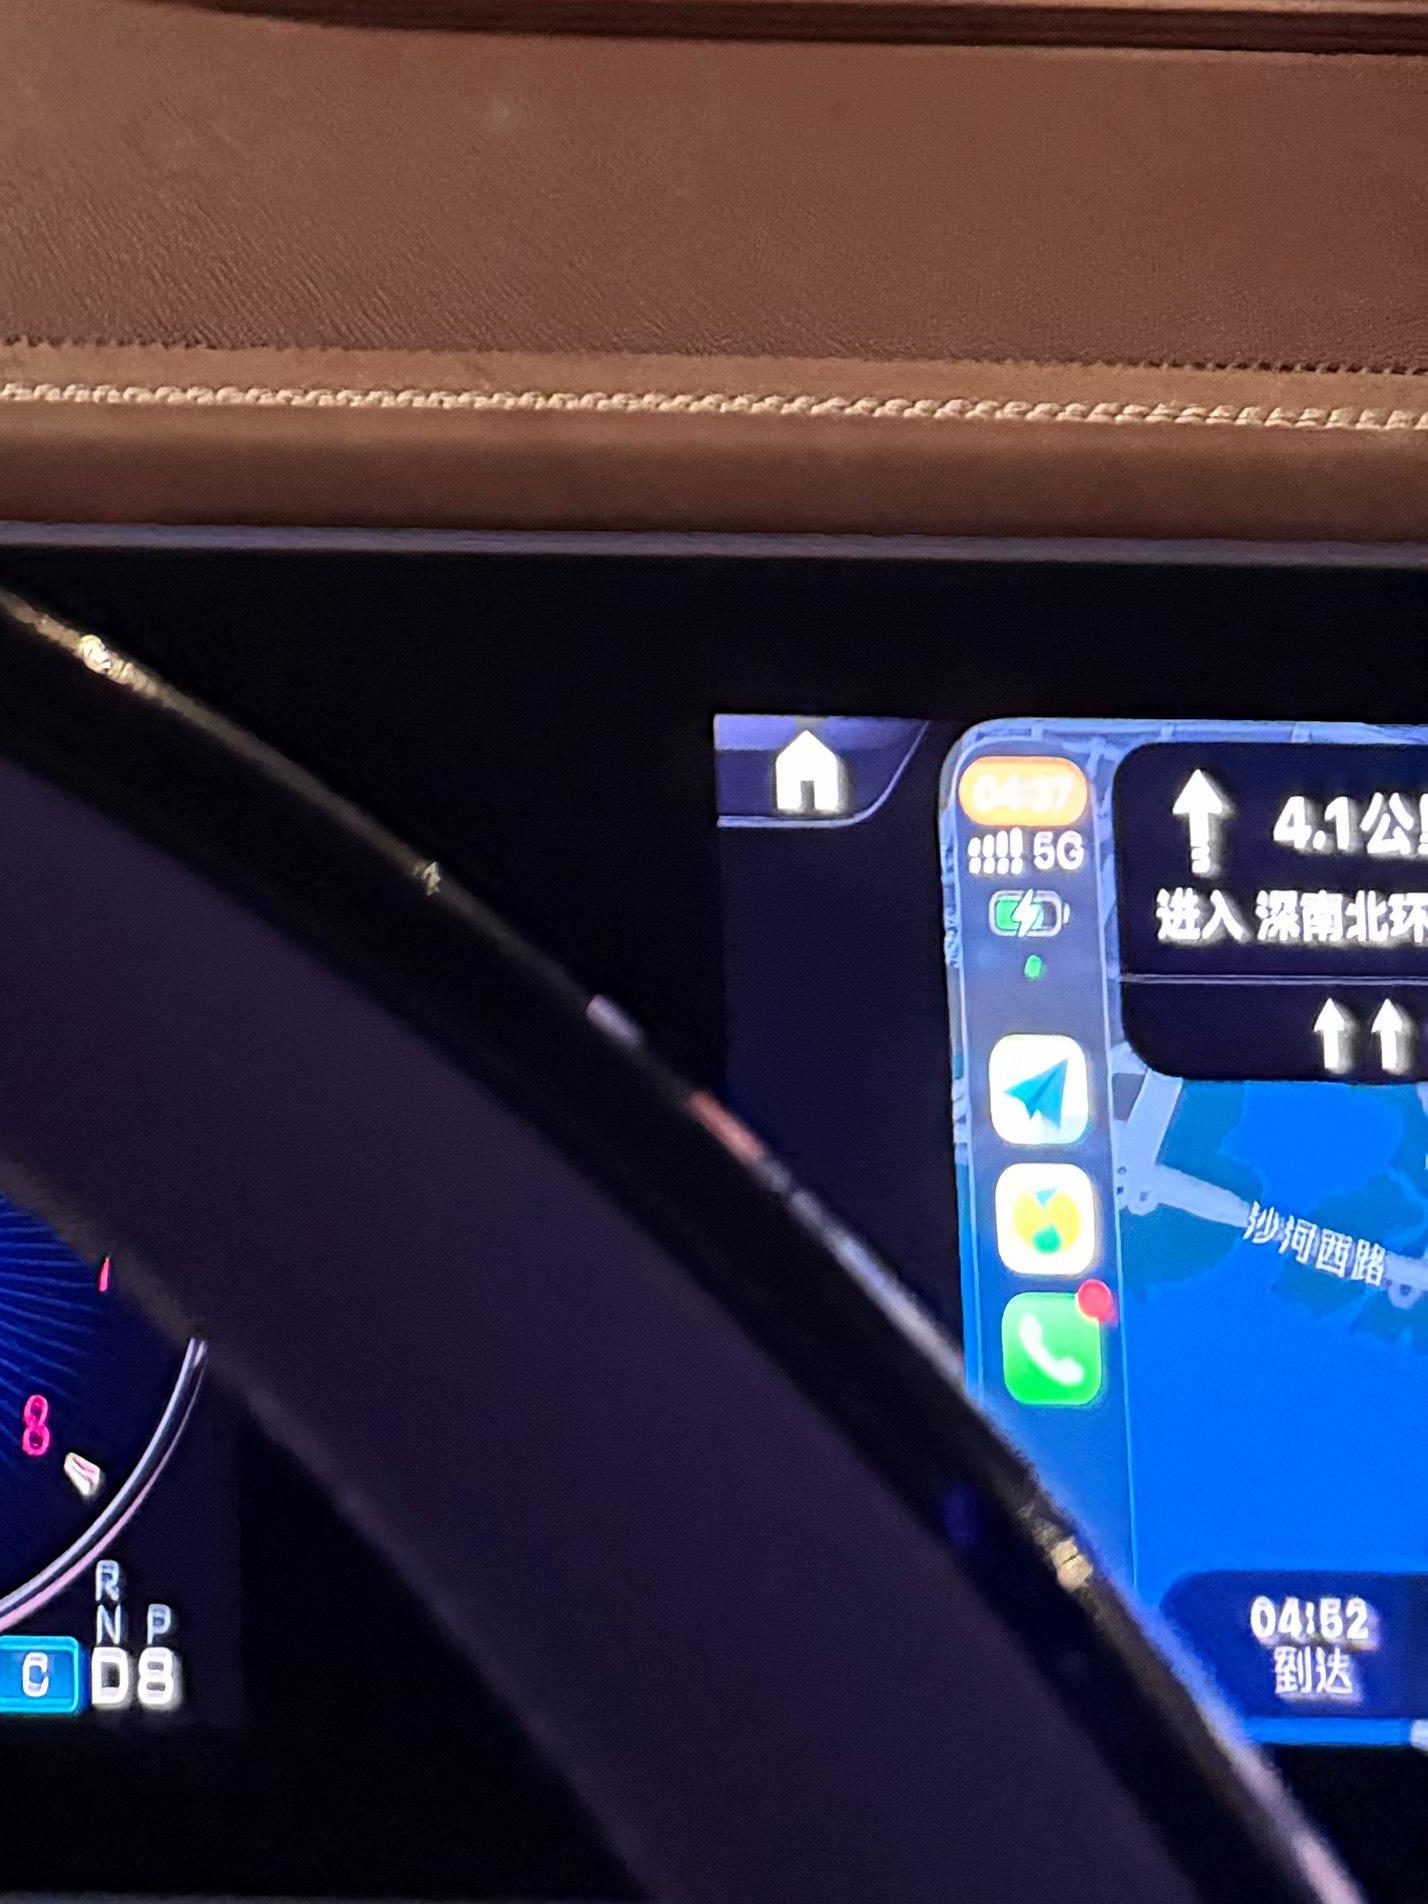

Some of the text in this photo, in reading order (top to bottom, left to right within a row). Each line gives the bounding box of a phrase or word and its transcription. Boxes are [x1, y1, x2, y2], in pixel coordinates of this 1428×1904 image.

[1033, 831, 1085, 872] 5G
[1155, 887, 1245, 942] 进入
[1243, 1201, 1386, 1286] 沙河西路
[22, 1394, 50, 1456] 8
[95, 1560, 120, 1601] R
[96, 1604, 121, 1645] N
[147, 1604, 171, 1645] P
[1250, 1596, 1369, 1641] 04:52
[22, 1652, 49, 1698] C
[1274, 1645, 1353, 1694] 到达
